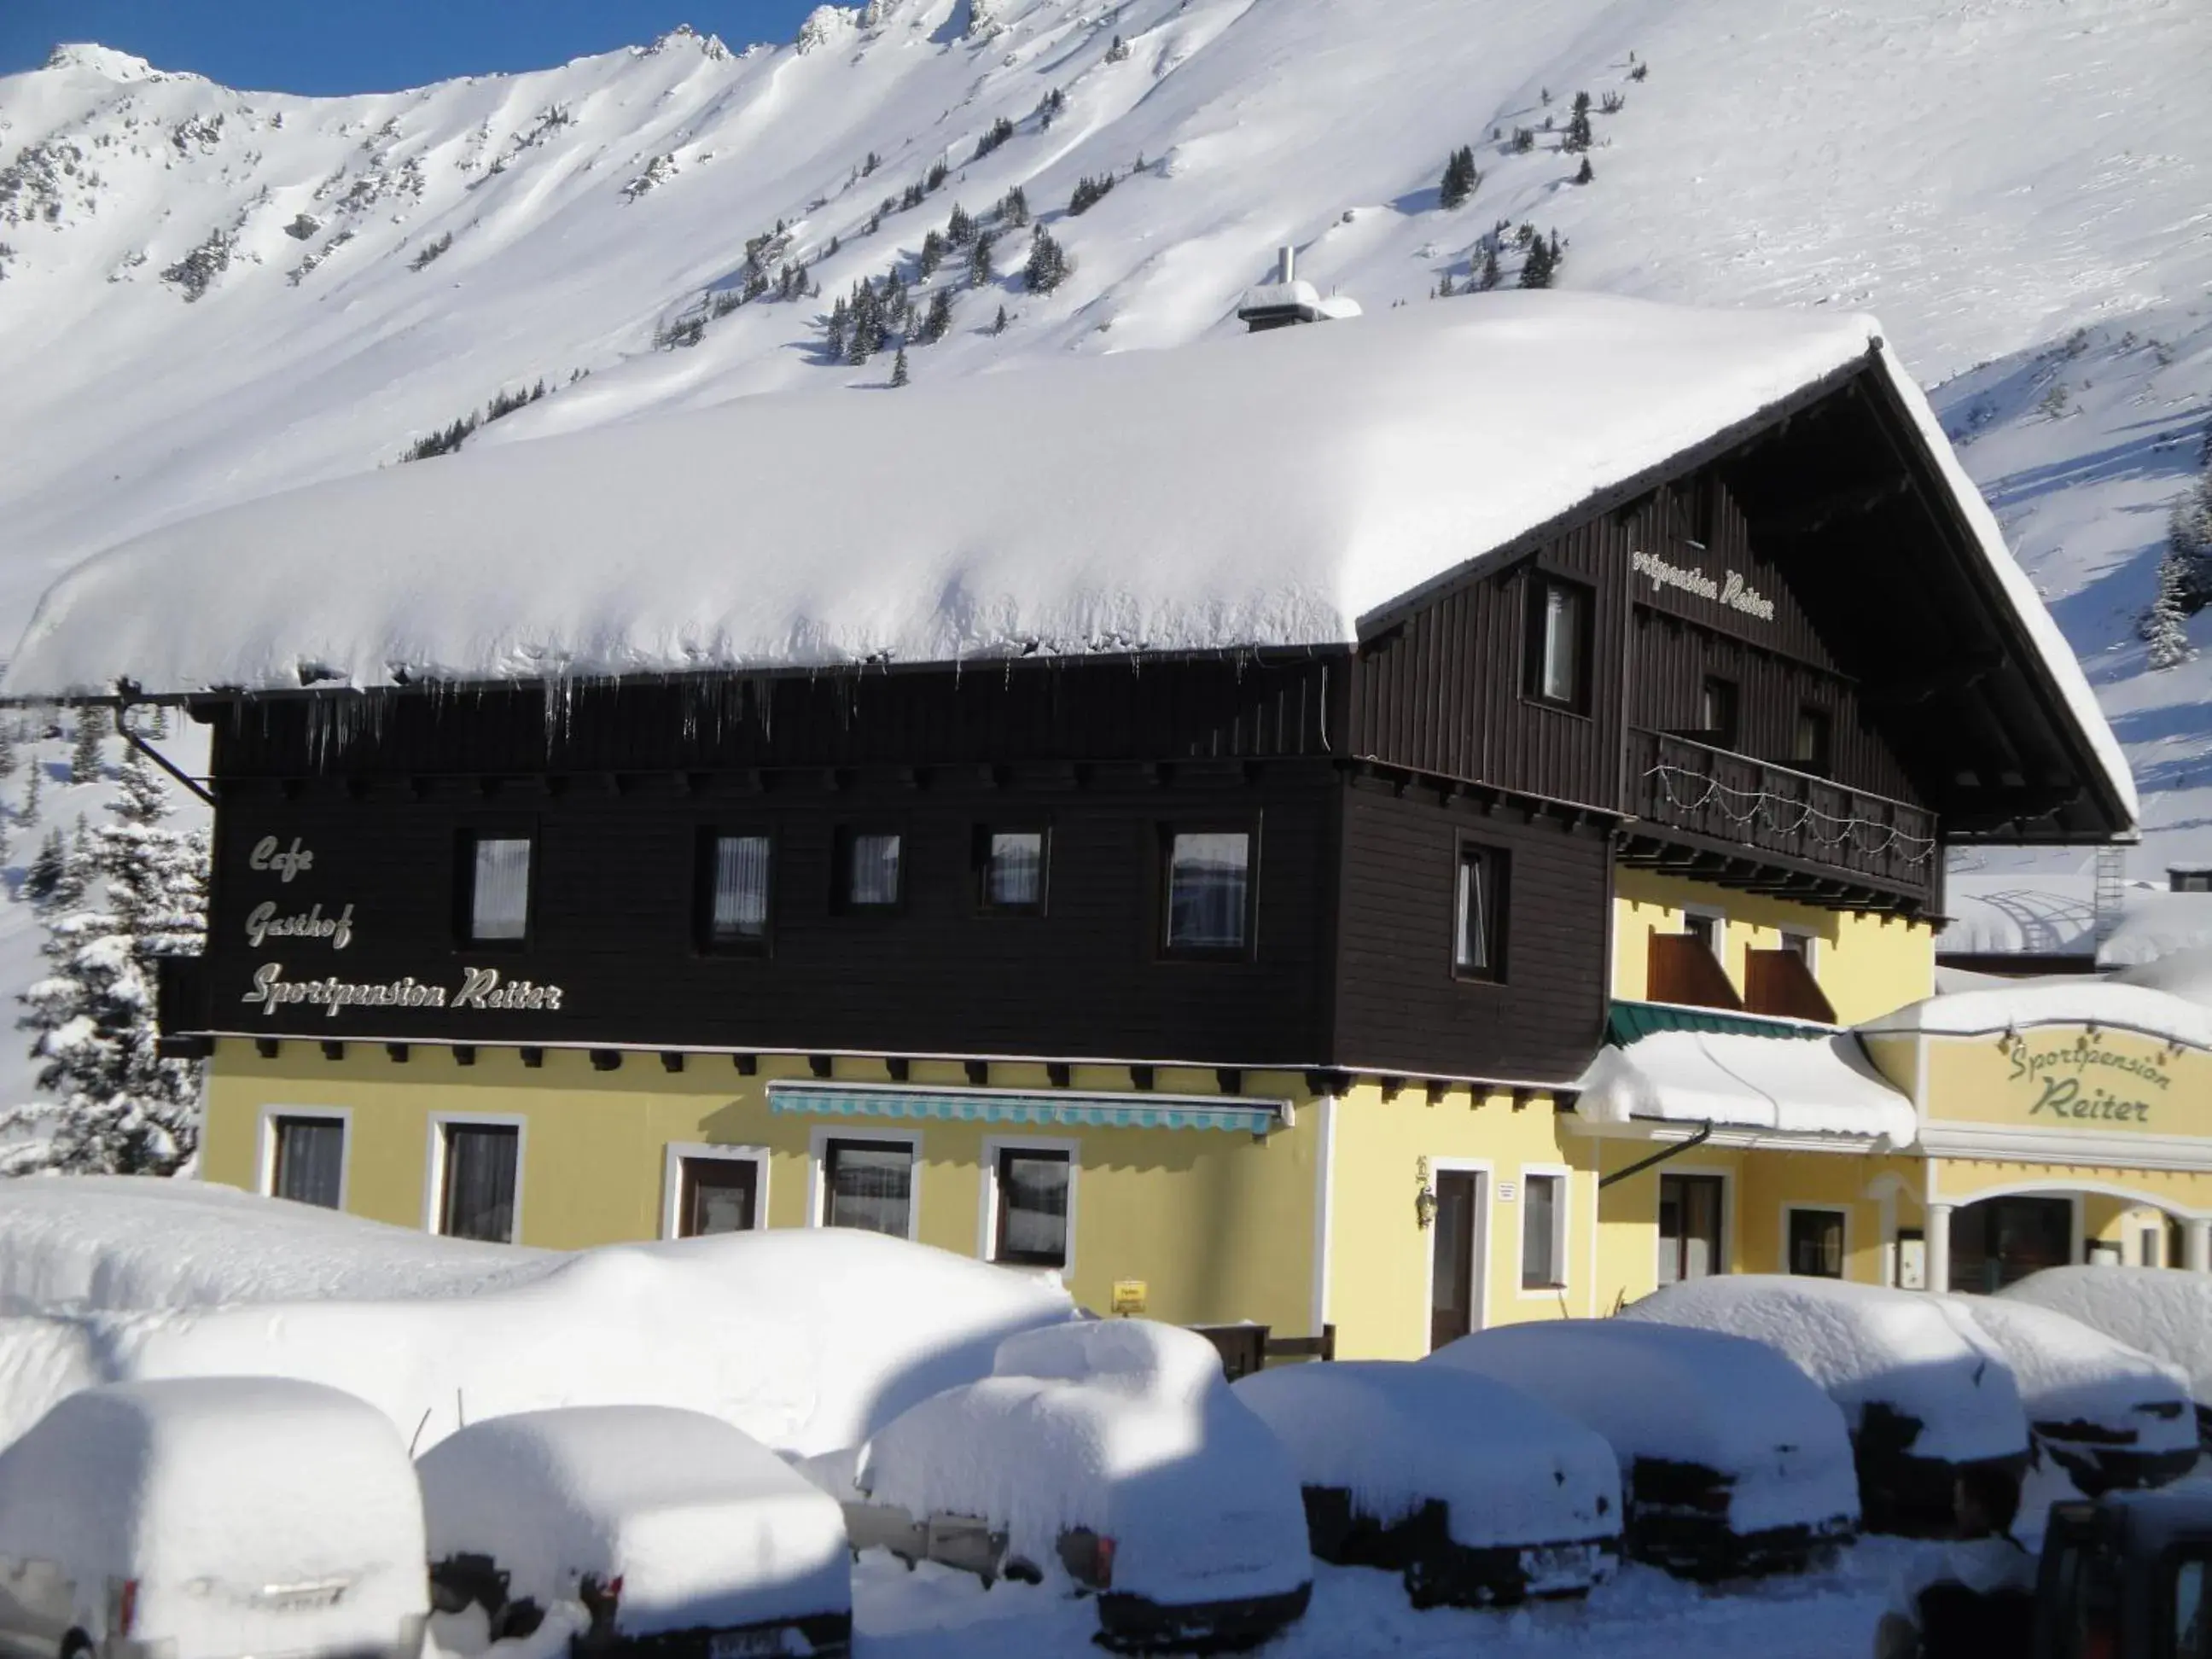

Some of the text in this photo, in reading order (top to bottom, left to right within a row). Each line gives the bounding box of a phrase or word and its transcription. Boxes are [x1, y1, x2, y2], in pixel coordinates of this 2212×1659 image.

[1632, 550, 1774, 621] ortpension Reiter
[249, 835, 315, 882] Cafe
[245, 900, 355, 950] Gasthof
[242, 962, 564, 1017] Sportpension Reiter
[2007, 1045, 2172, 1091] Sportpension
[2029, 1075, 2150, 1122] Reiter
